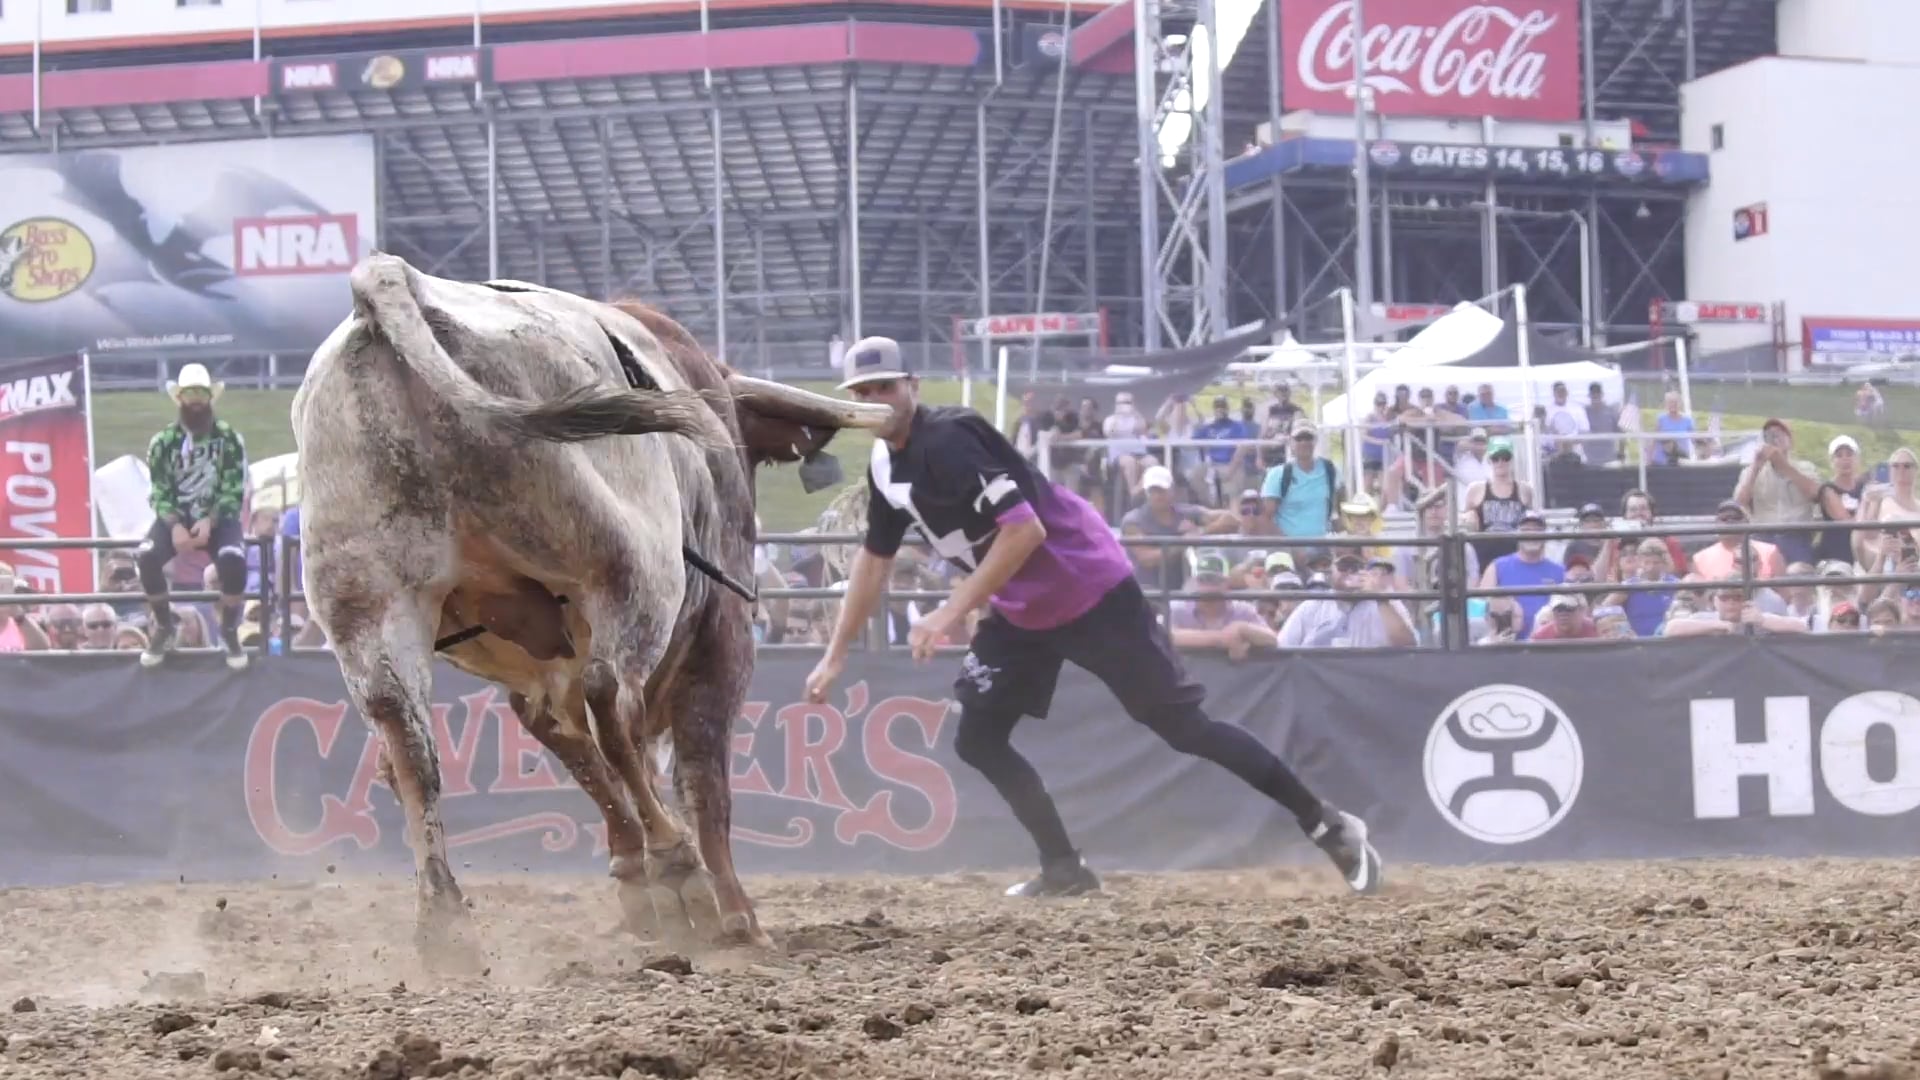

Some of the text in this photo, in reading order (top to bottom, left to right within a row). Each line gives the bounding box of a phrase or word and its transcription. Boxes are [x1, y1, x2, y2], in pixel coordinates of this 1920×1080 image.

[284, 64, 334, 88] NRA
[427, 55, 477, 79] NRA
[1411, 148, 1488, 168] GATES
[25, 224, 67, 246] Bass
[241, 221, 351, 270] NRA
[27, 243, 59, 267] Pro
[26, 262, 80, 291] Shops
[0, 371, 76, 414] MAX
[6, 440, 62, 595] POWE
[244, 678, 957, 857] CVEER'S
